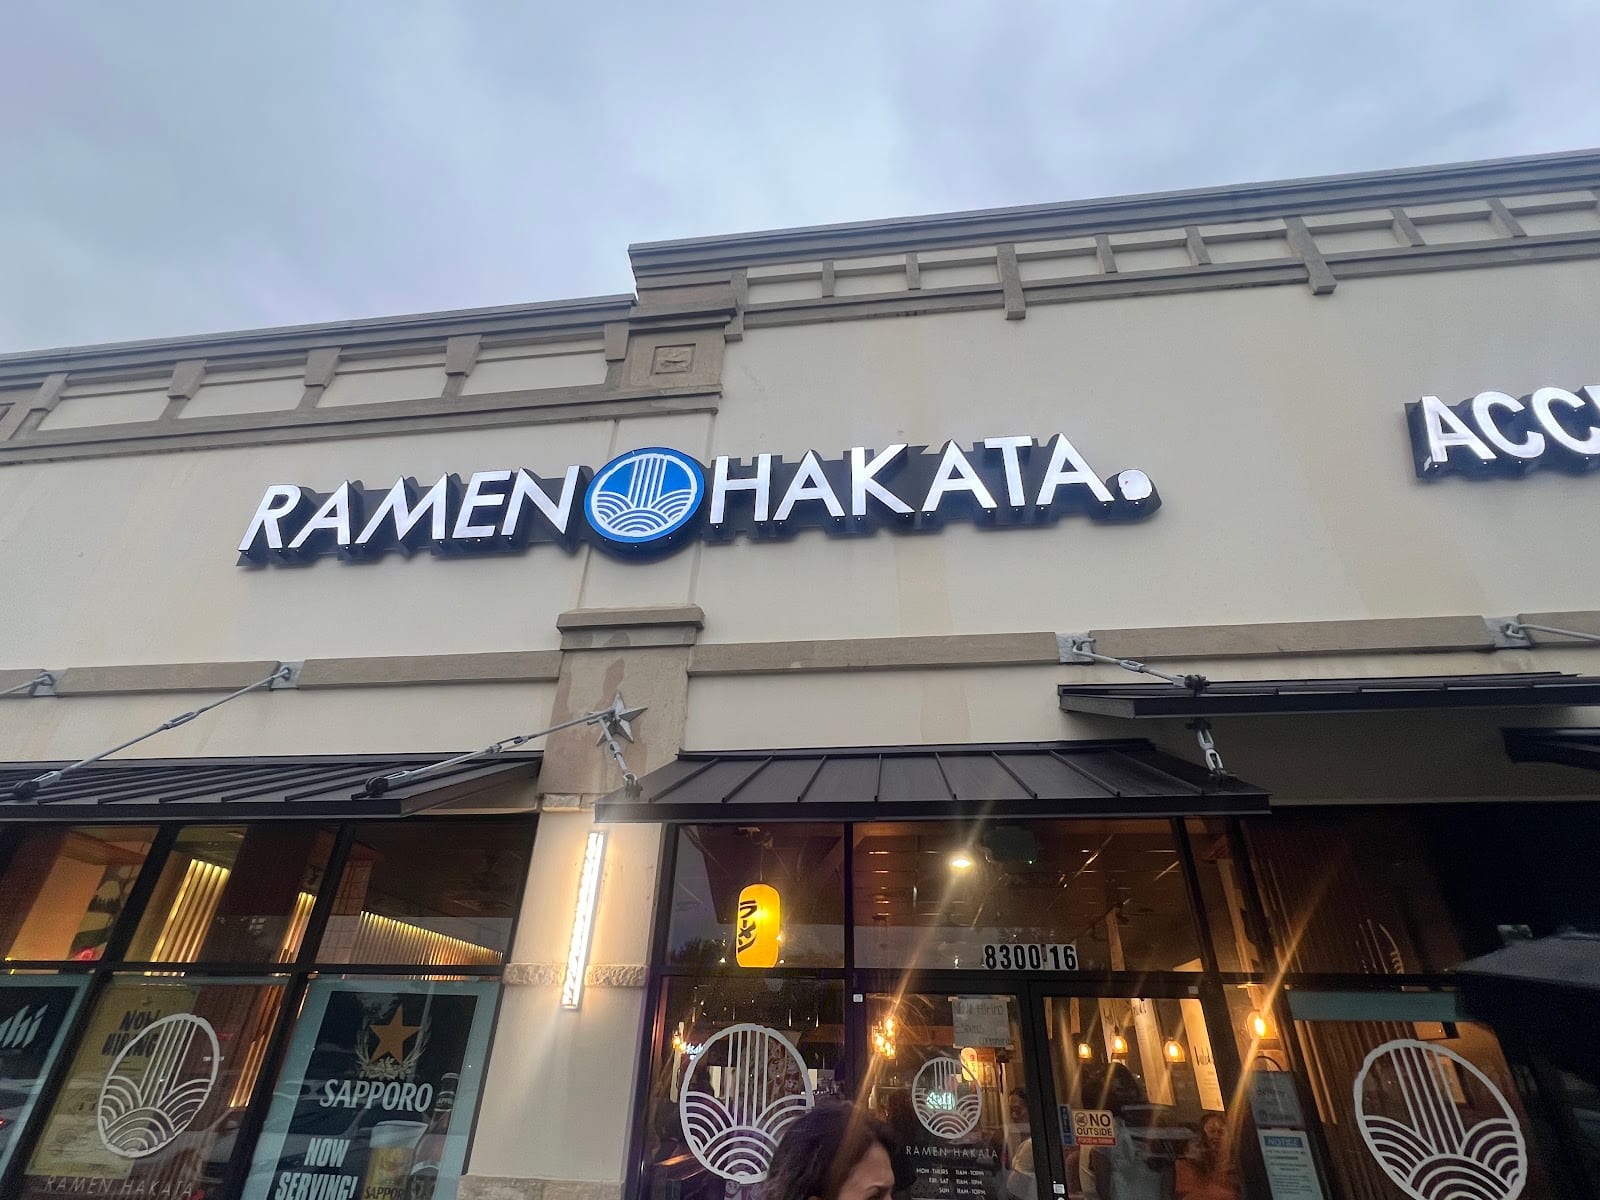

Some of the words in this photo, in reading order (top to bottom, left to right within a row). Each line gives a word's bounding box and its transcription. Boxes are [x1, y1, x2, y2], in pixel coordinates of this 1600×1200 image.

[238, 465, 580, 551] RAMEN
[737, 899, 758, 953] ラーメン
[984, 944, 1041, 970] 8300
[1049, 945, 1077, 970] 16
[319, 1078, 433, 1113] SAPPORO
[1076, 1127, 1113, 1137] OUTSIDE
[1089, 1113, 1111, 1127] NO
[303, 1137, 350, 1168] NOW
[906, 1145, 947, 1157] RAMEN
[953, 1147, 998, 1160] HAKATA
[44, 1175, 113, 1195] RAMEN
[119, 1179, 194, 1197] HAKATA
[274, 1171, 359, 1200] SERVING!
